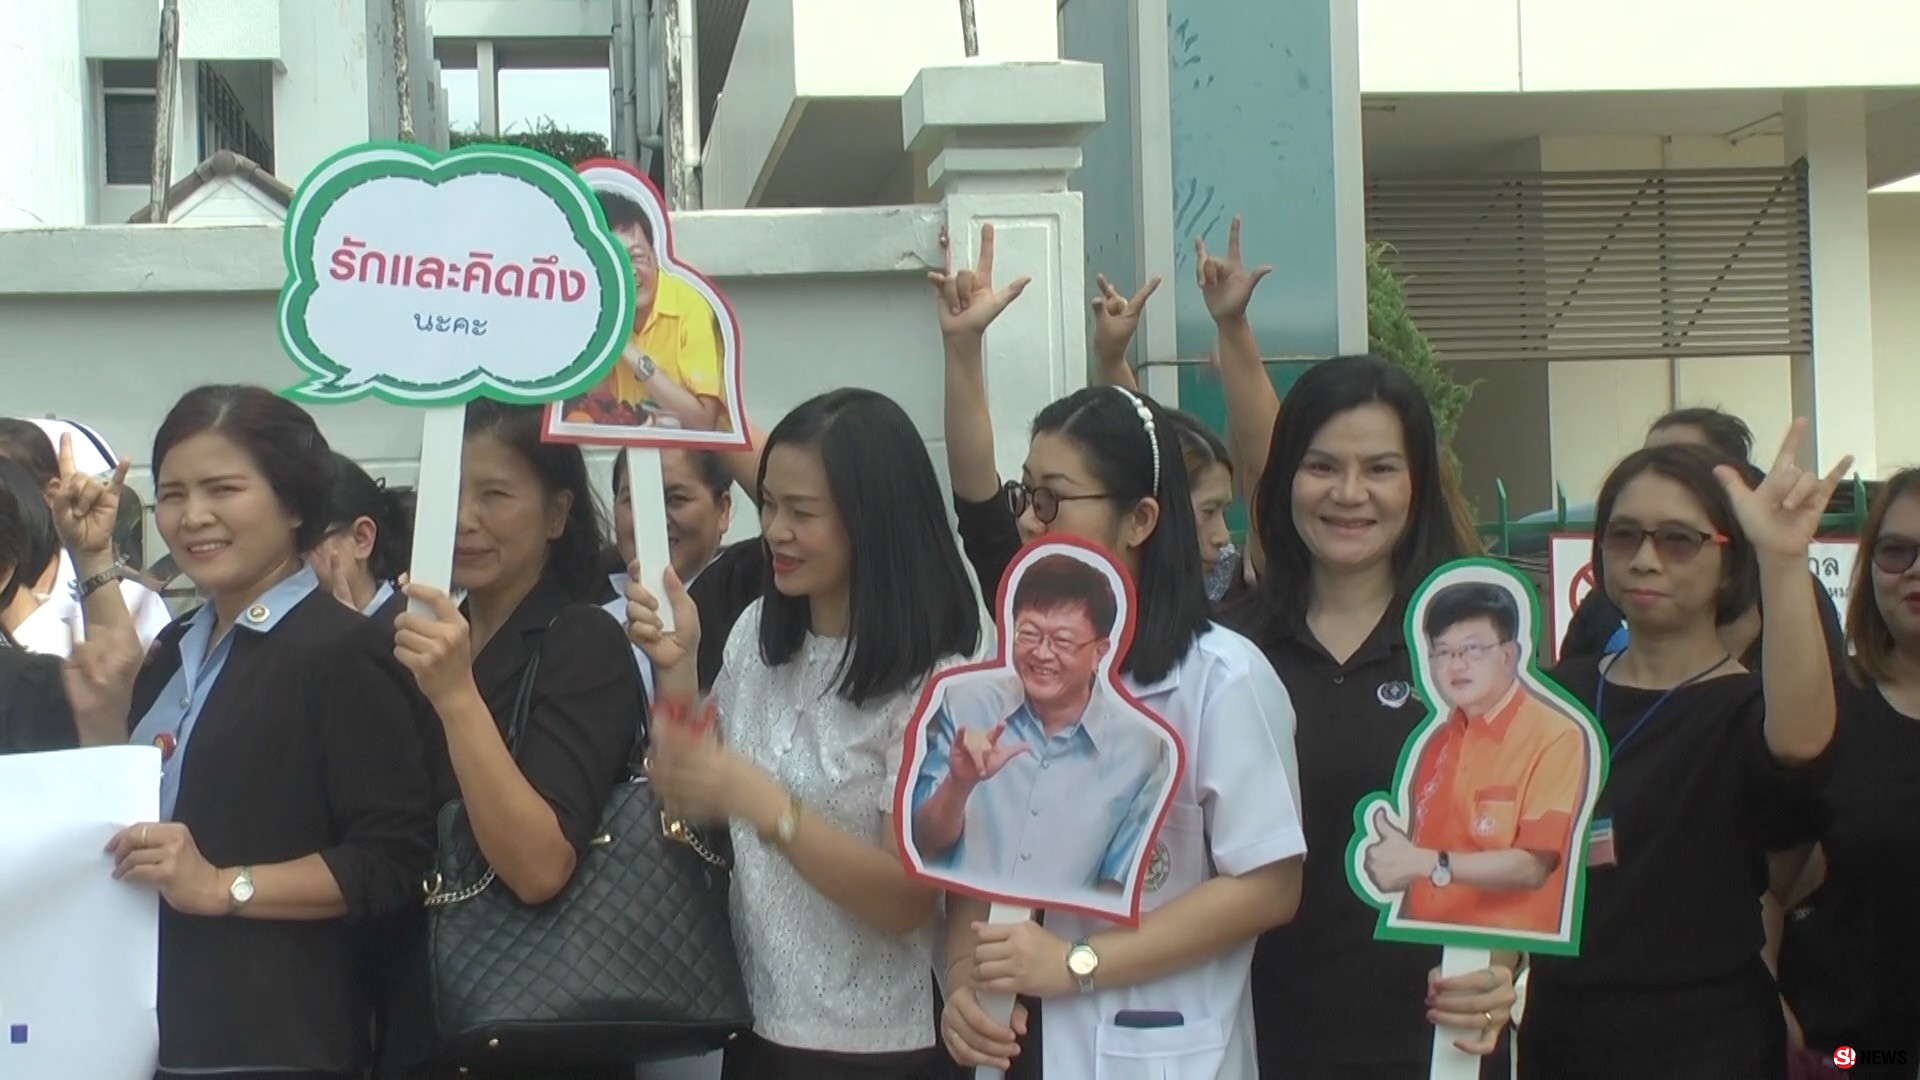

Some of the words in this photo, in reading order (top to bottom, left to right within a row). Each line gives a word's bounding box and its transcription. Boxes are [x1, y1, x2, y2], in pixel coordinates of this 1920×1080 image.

[329, 236, 586, 302] รักและคิดถึง
[413, 312, 488, 336] นะคะ
